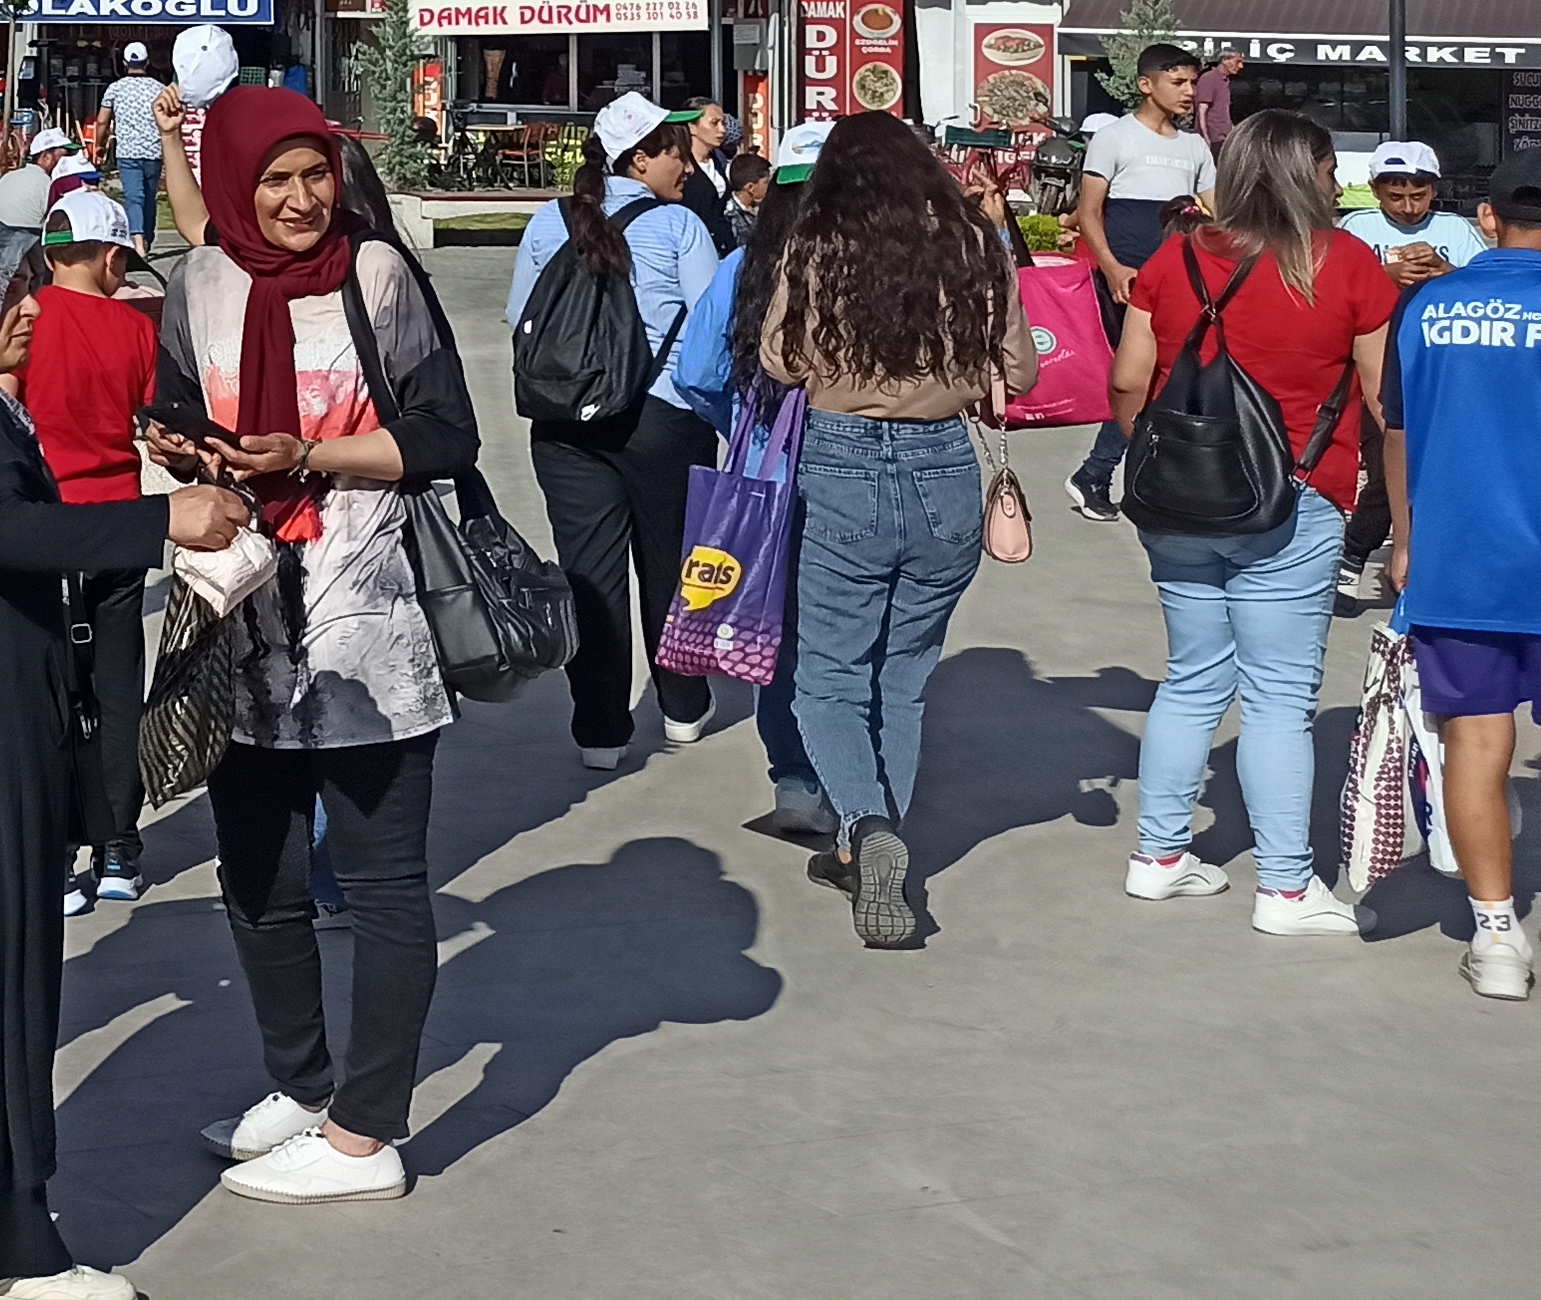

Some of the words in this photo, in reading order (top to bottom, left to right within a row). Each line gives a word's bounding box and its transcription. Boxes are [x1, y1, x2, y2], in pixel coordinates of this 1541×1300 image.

[418, 4, 509, 28] DAMAK
[518, 0, 611, 26] DÜRÜM
[800, 1, 845, 18] DAMAK
[1421, 299, 1522, 320] ALAGÖZ
[1476, 913, 1511, 932] 23
